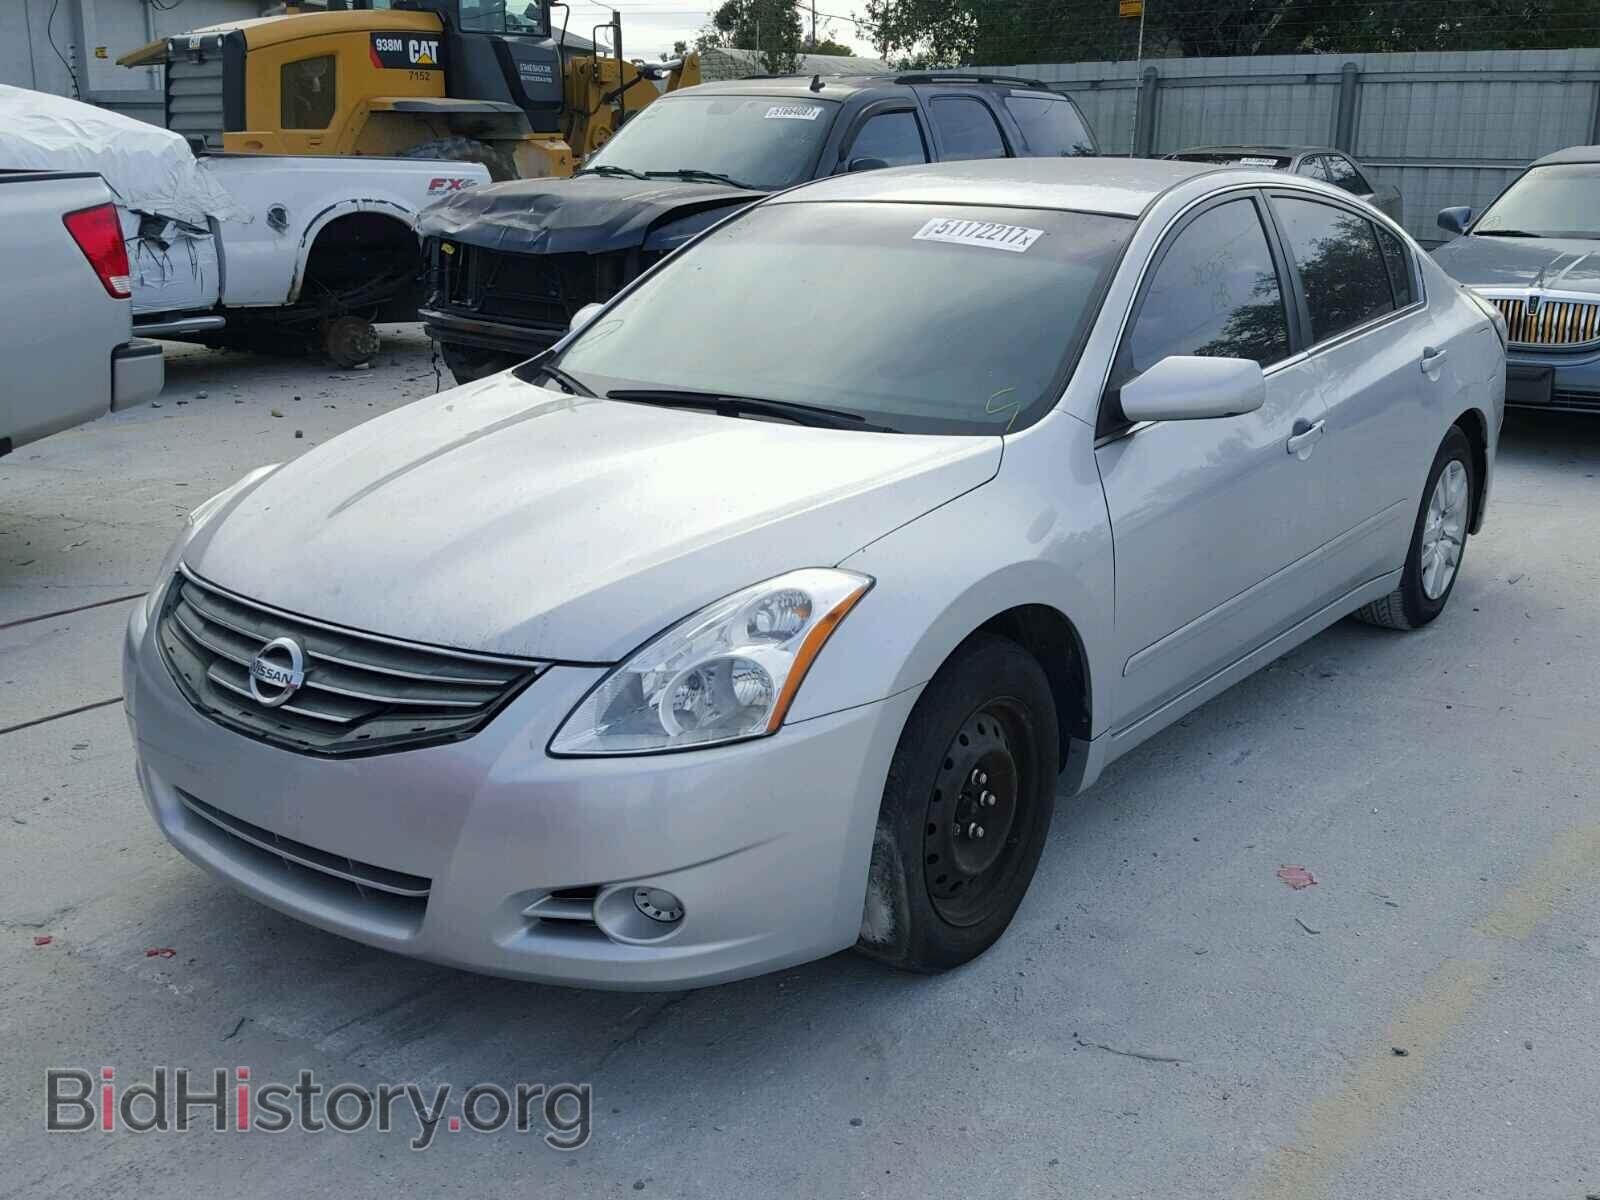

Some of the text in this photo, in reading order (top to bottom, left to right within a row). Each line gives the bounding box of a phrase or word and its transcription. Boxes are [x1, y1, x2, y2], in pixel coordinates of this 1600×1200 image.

[375, 38, 403, 52] 938M
[408, 39, 439, 64] CAT
[408, 71, 431, 81] 7152
[252, 659, 294, 684] NISSAN
